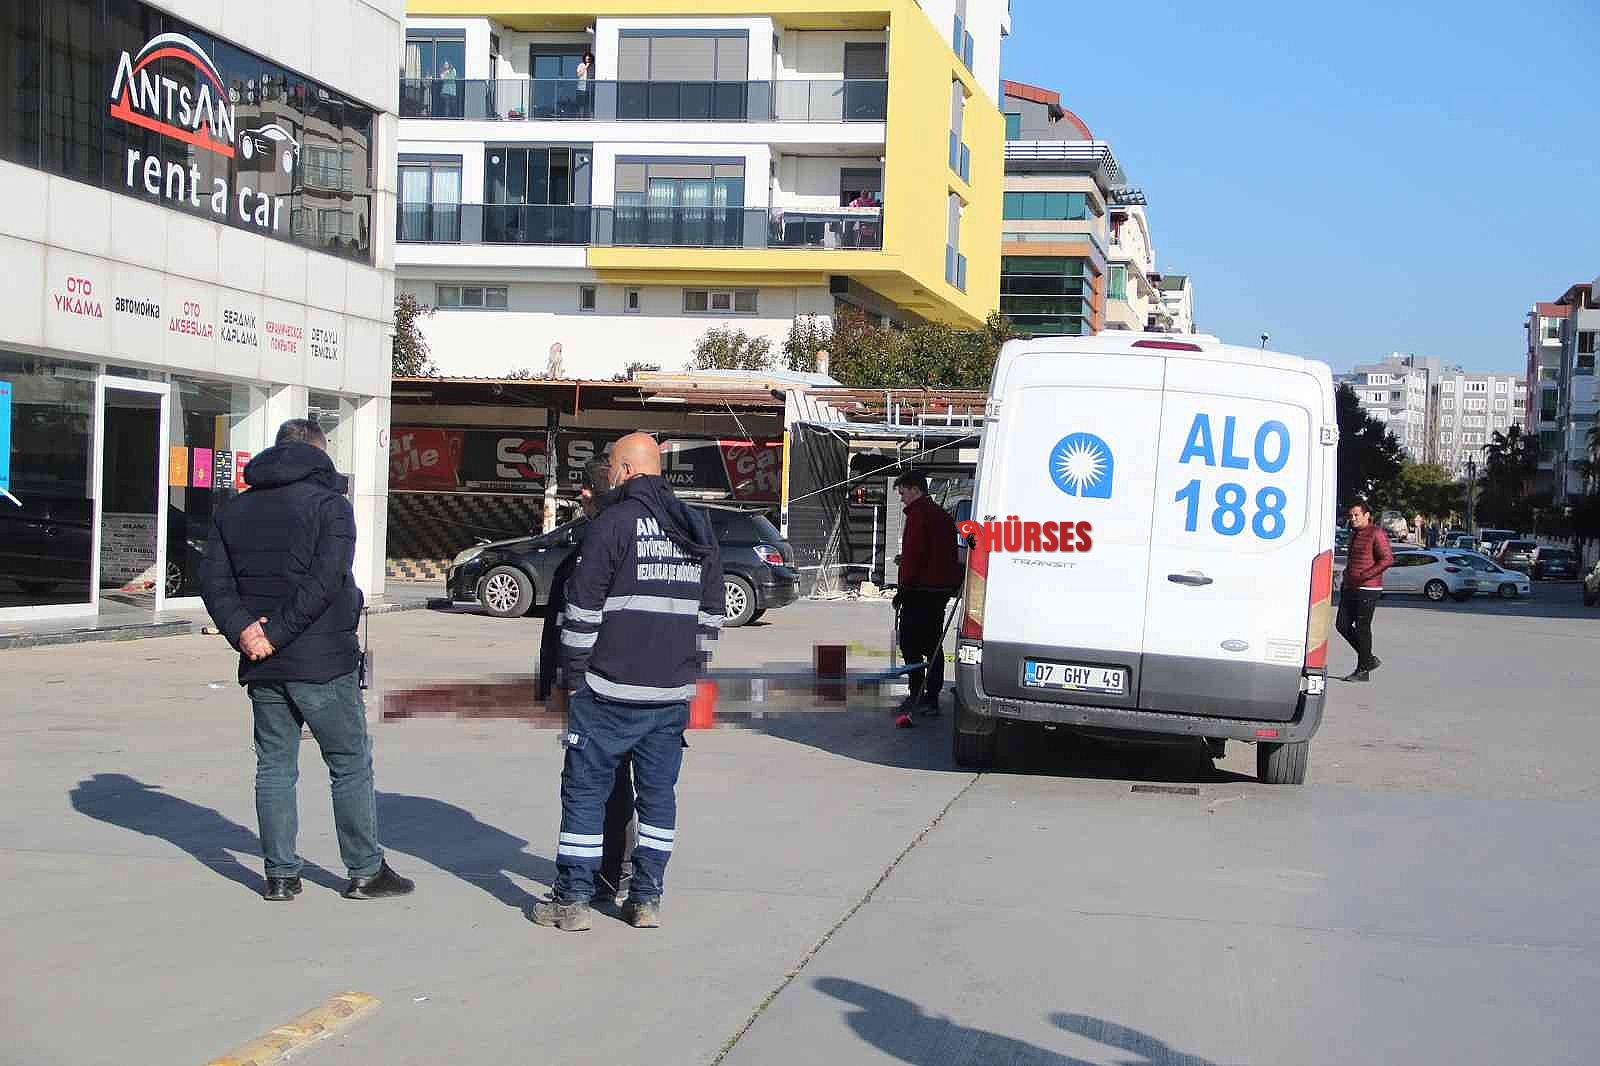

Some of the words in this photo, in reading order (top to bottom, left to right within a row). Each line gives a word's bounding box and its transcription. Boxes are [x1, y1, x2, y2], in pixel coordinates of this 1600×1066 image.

[111, 50, 235, 144] ANTSAN
[127, 148, 201, 208] rent
[211, 177, 228, 215] a
[239, 184, 284, 232] car
[66, 276, 93, 296] OTO
[54, 294, 104, 319] YIKAMA
[115, 296, 160, 319] автомойка
[183, 301, 201, 317] OTO
[168, 317, 214, 337] AKSESUAR
[220, 327, 258, 348] KAPLAMA
[1179, 413, 1291, 474] ALO
[664, 472, 696, 484] WAX
[1175, 479, 1287, 540] 188
[1010, 558, 1077, 568] TRANSIT
[1036, 665, 1053, 682] 07
[1064, 667, 1091, 685] GHY
[1103, 671, 1120, 688] 49
